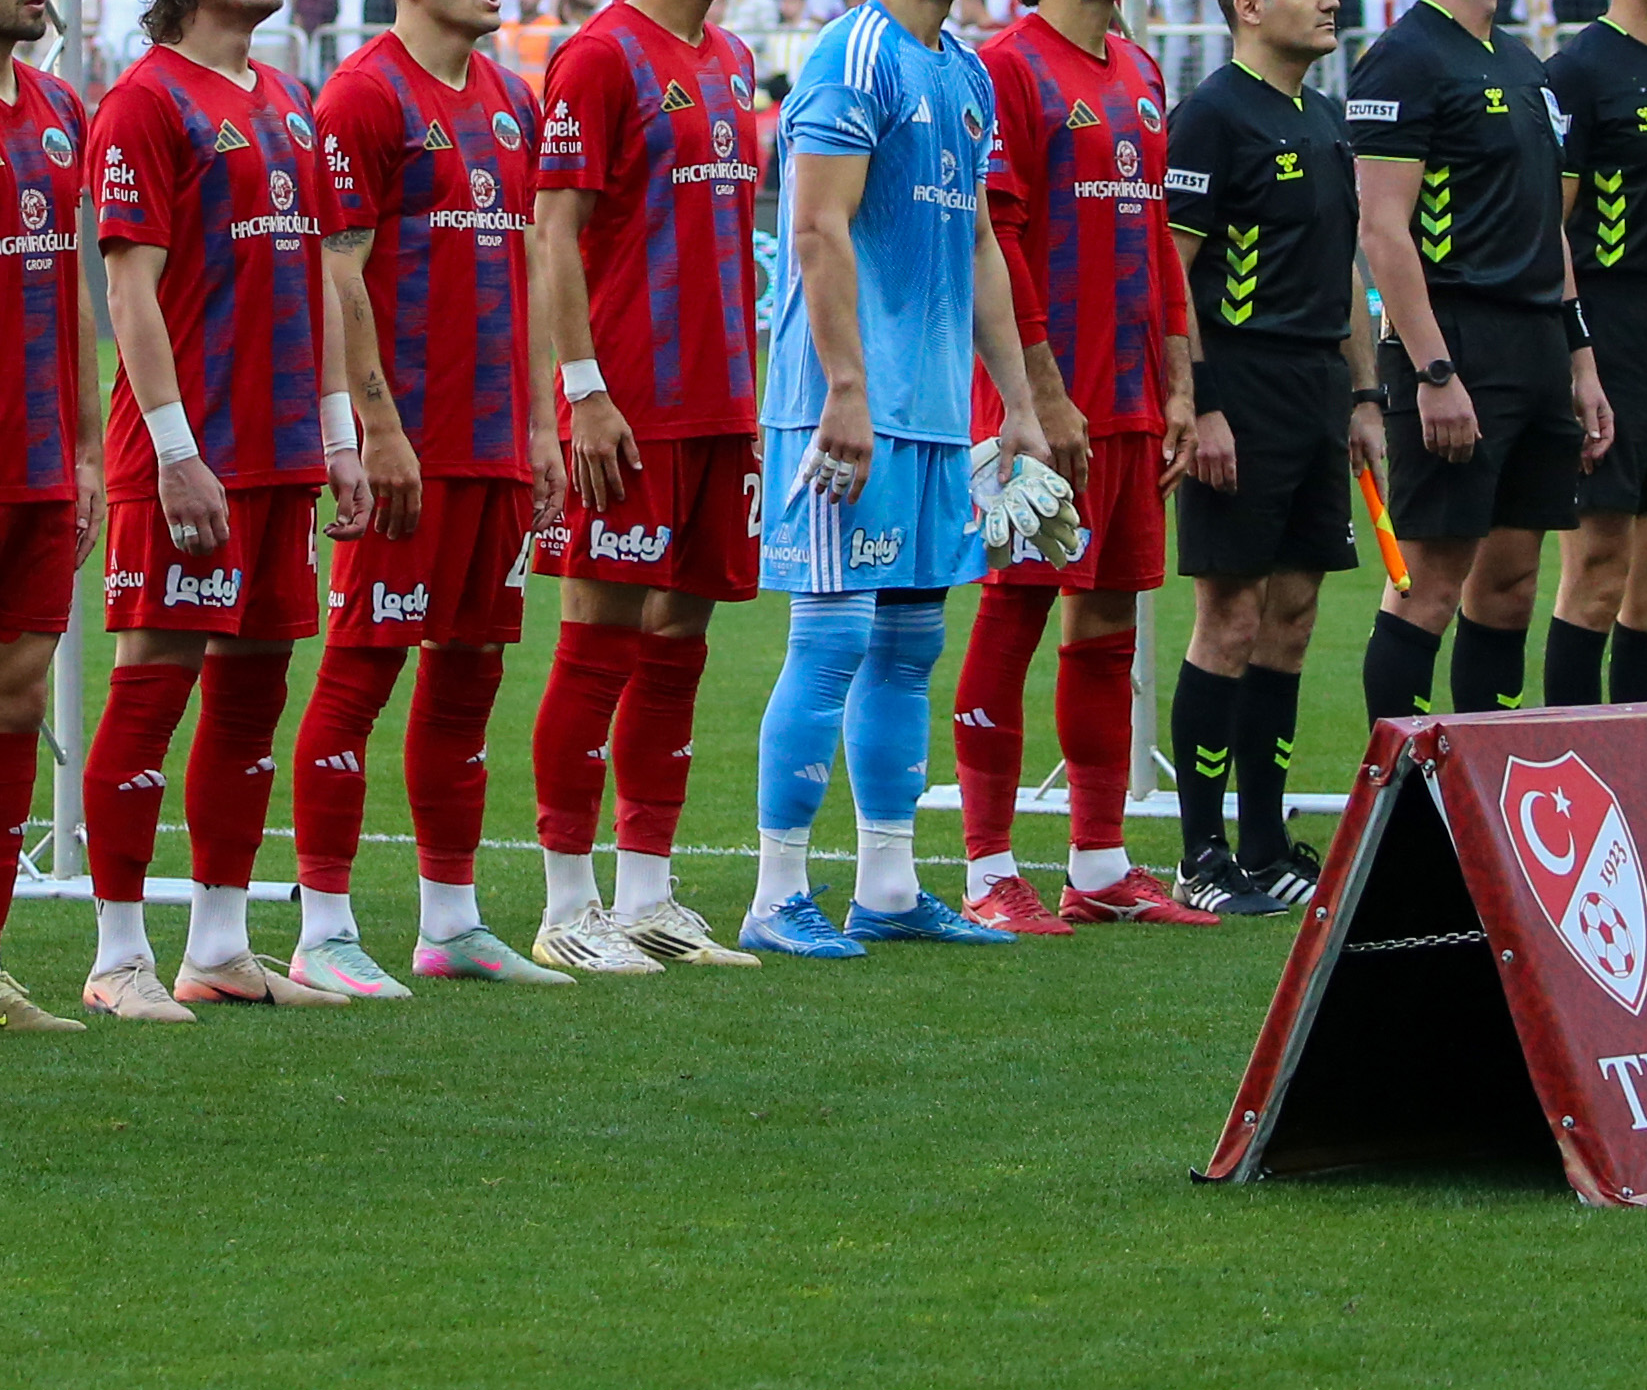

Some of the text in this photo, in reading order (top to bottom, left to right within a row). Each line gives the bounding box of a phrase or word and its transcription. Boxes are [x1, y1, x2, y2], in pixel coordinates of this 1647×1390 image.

[275, 239, 301, 251] GROUP
[477, 234, 502, 247] GROUP
[25, 258, 53, 271] GROUP
[590, 518, 672, 563] Lody
[164, 563, 243, 607] Lody
[371, 579, 430, 624] Lod
[1598, 838, 1631, 890] 1923
